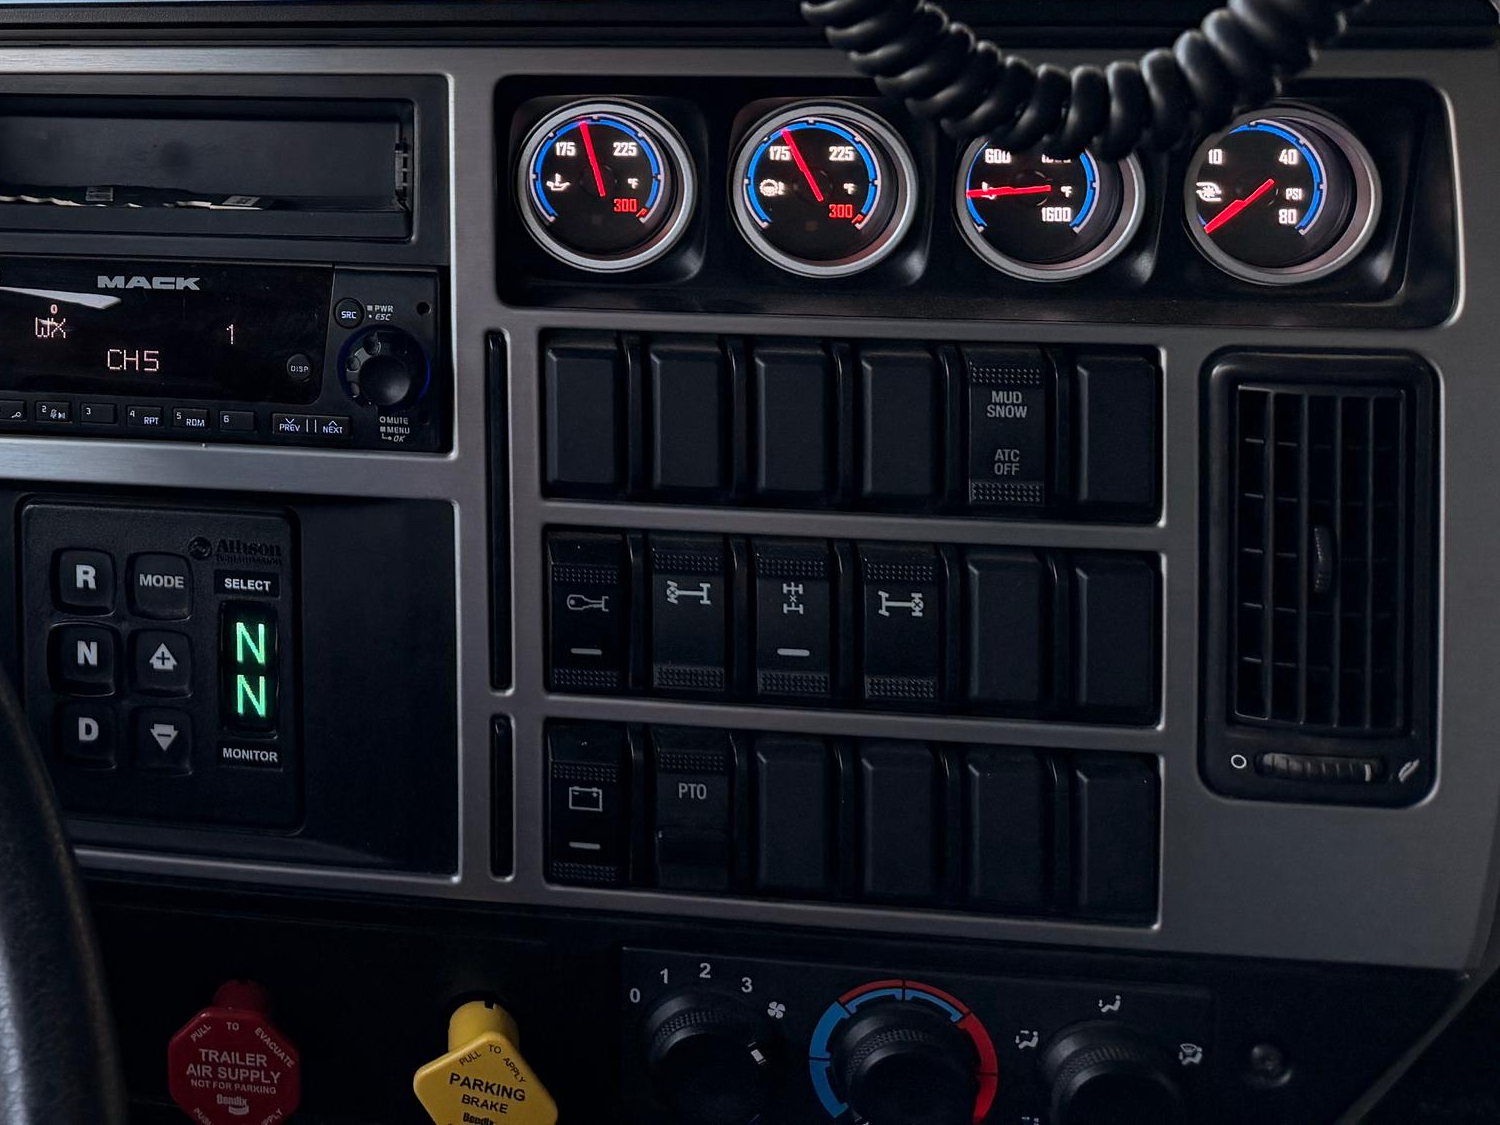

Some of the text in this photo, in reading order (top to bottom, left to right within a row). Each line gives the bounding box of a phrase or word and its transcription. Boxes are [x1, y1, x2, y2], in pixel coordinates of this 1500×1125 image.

[555, 141, 576, 157] 175
[613, 141, 637, 157] 225
[769, 145, 792, 161] 175
[829, 146, 854, 162] 225
[984, 148, 1012, 164] 600
[1208, 148, 1223, 165] 10
[1278, 149, 1298, 165] 40
[1285, 188, 1303, 201] PSI
[613, 198, 638, 213] 300
[828, 203, 854, 219] 300
[1041, 207, 1072, 223] 1600
[1278, 209, 1297, 225] 80
[97, 275, 200, 291] MACK
[341, 310, 357, 319] SRC
[374, 305, 393, 313] PWR
[375, 313, 392, 321] ESC
[35, 316, 67, 339] WX
[226, 323, 235, 345] 1
[106, 347, 160, 372] CH5
[290, 365, 309, 373] DISP
[991, 390, 1023, 404] MUD
[41, 405, 47, 413] 2
[85, 407, 91, 415] 3
[129, 410, 136, 418] 4
[176, 412, 182, 420] 5
[986, 404, 1028, 419] SNOW
[143, 416, 160, 425] RPT
[186, 418, 205, 427] RDM
[223, 414, 230, 423] 6
[386, 416, 409, 425] MUTE
[279, 423, 301, 432] PREV
[322, 425, 343, 434] NEXT
[386, 426, 411, 435] MENU
[393, 434, 406, 443] OK
[994, 448, 1021, 463] ATC
[994, 462, 1020, 476] OFF
[75, 564, 97, 590] R
[139, 573, 185, 589] MODE
[224, 577, 272, 592] SELECT
[235, 621, 266, 666] N
[76, 640, 98, 667] N
[236, 674, 267, 718] N
[78, 715, 100, 743] D
[222, 747, 278, 763] MONITOR
[678, 782, 707, 800] PTO
[659, 967, 669, 985] 1
[699, 962, 711, 979] 2
[741, 976, 753, 993] 3
[629, 987, 641, 1004] 0
[190, 1021, 296, 1068] PULL TO EVACUATE
[199, 1047, 268, 1068] TRAILER
[459, 1043, 527, 1083] PULL TO APPLY
[186, 1062, 281, 1085] AIR SUPPLY
[190, 1078, 277, 1095] NOT FOR PARKING
[449, 1071, 526, 1102] PARKING
[461, 1093, 509, 1115] BRAKE
